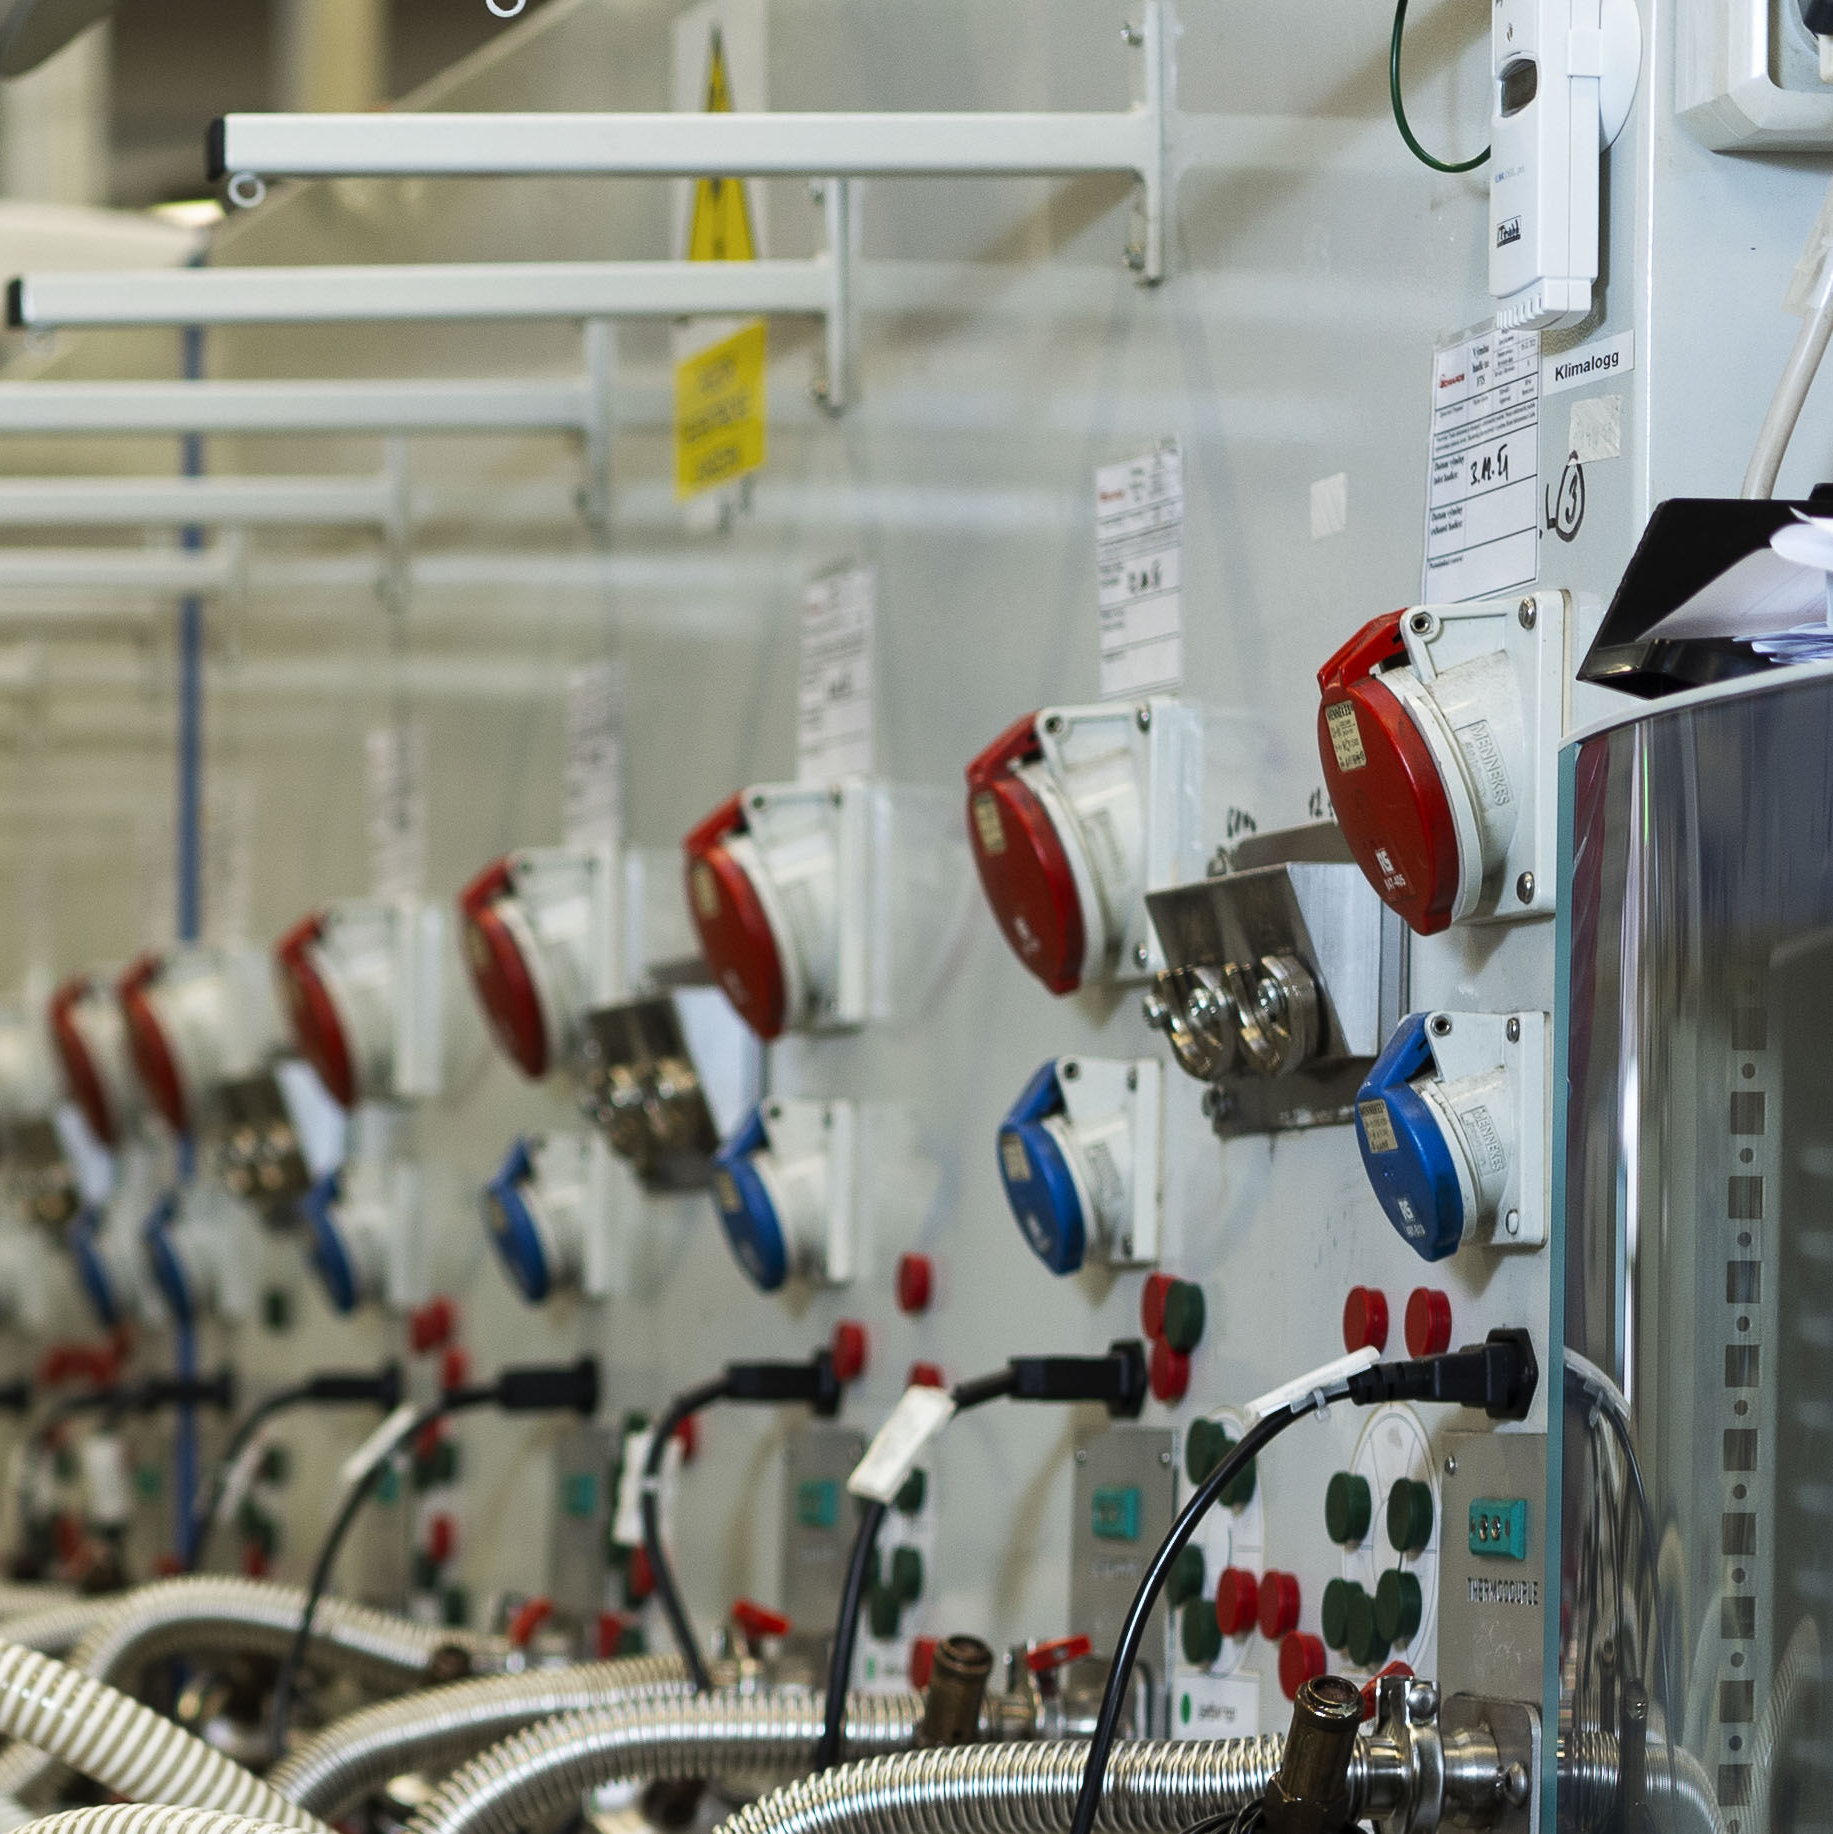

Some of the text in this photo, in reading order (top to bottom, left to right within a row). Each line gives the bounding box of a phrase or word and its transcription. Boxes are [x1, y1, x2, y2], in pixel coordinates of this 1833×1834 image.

[1555, 352, 1620, 381] Klimalogg
[1470, 722, 1510, 807] MENNEKES
[1473, 1104, 1506, 1173] MENNEKES
[1468, 1577, 1539, 1605] THERMOCOUPLE
